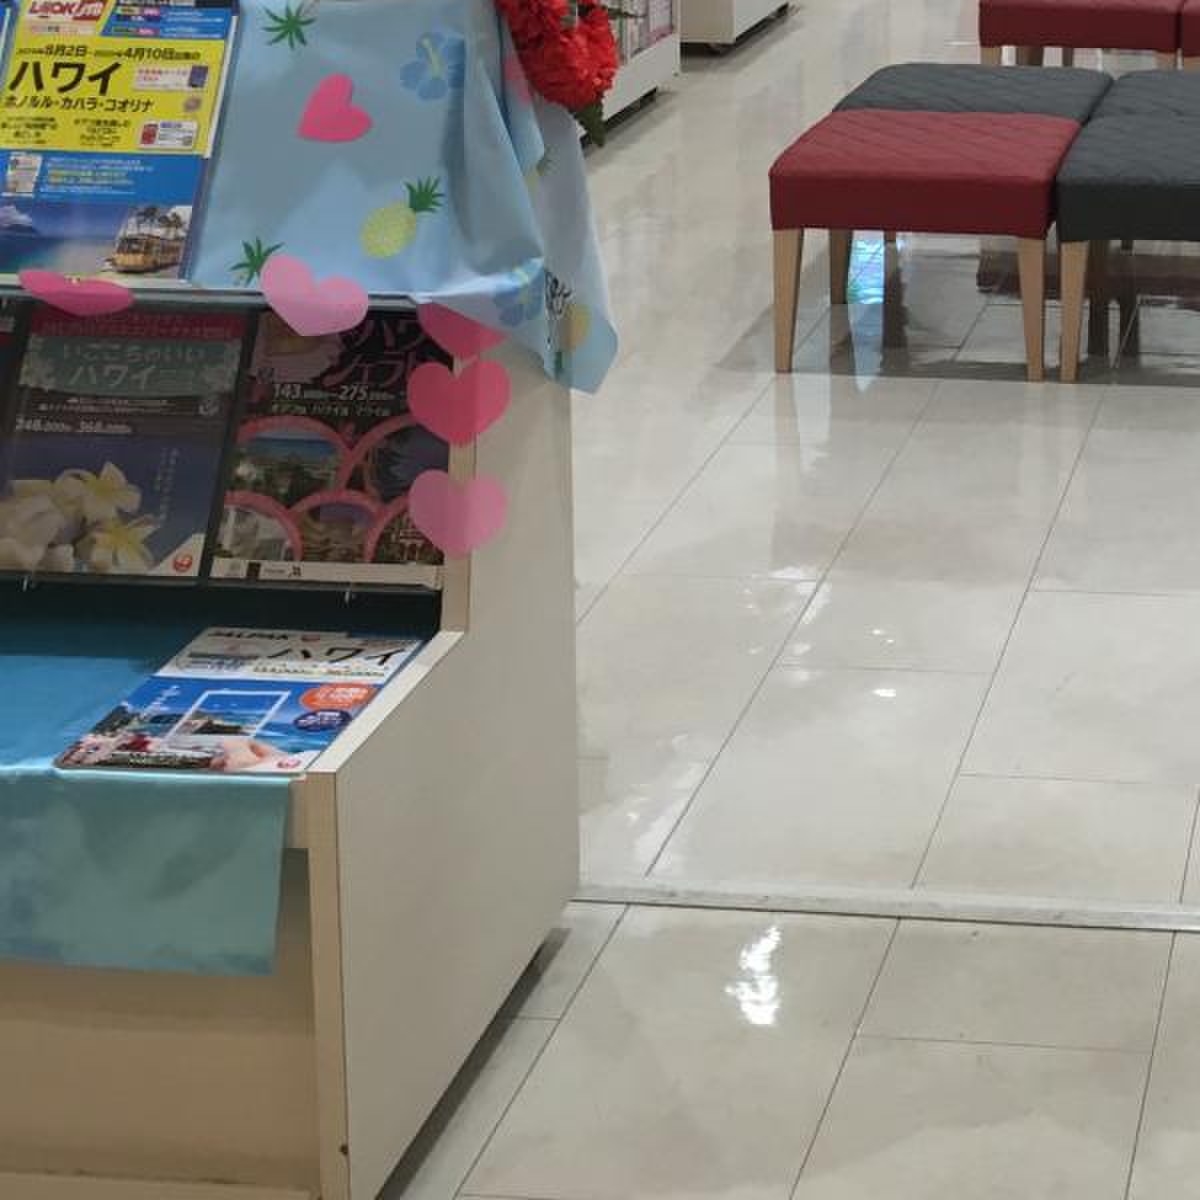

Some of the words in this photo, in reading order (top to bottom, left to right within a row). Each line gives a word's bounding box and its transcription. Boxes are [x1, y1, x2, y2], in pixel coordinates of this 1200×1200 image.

[9, 61, 122, 96] ハワイ
[69, 363, 152, 387] ハワイ
